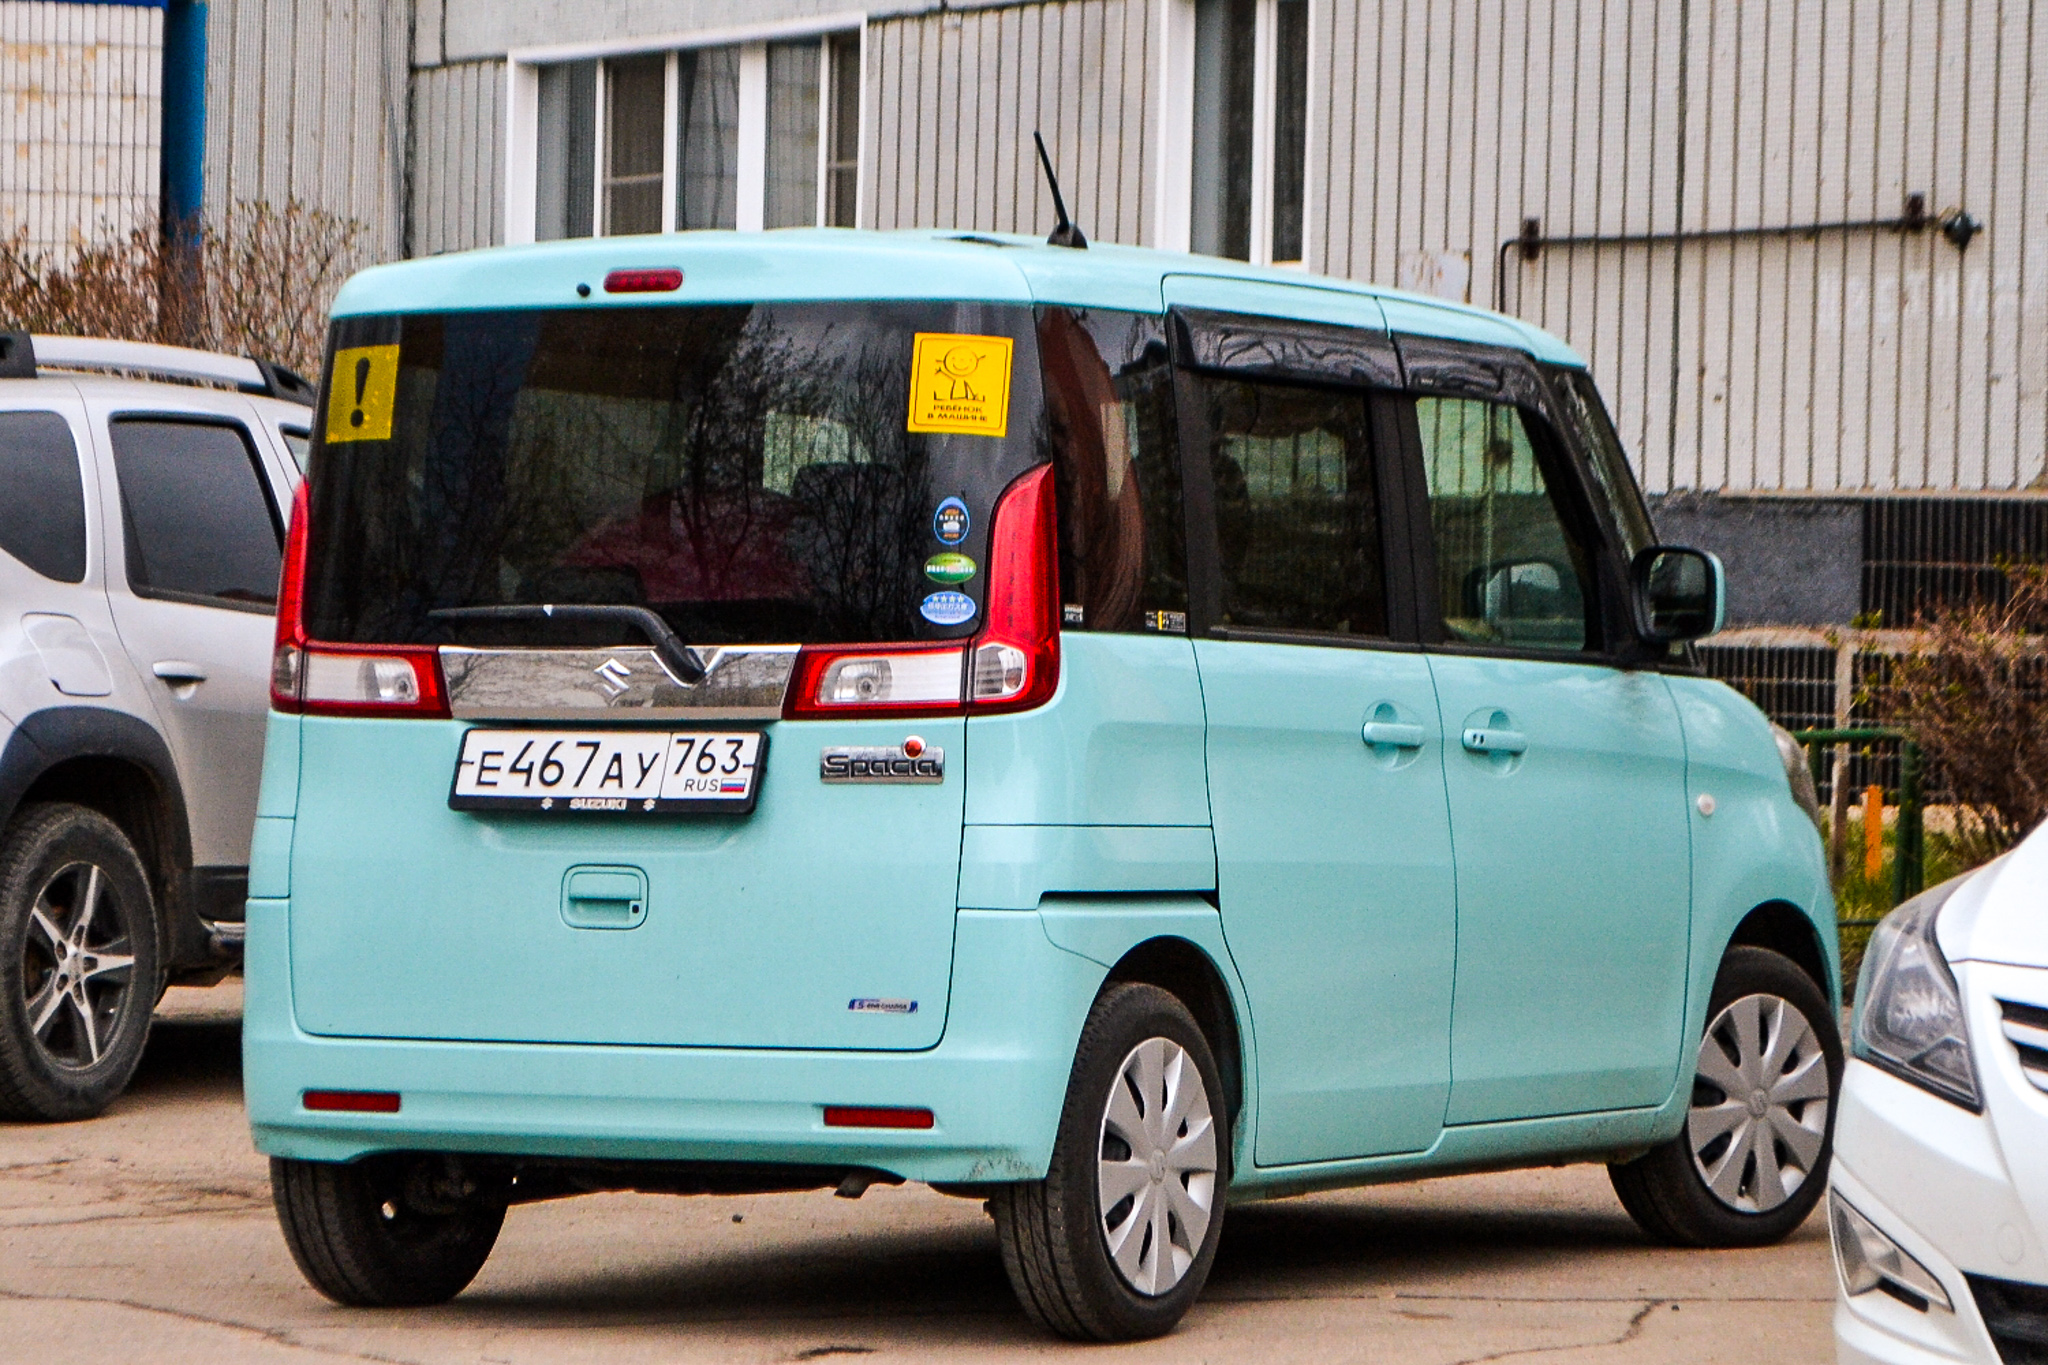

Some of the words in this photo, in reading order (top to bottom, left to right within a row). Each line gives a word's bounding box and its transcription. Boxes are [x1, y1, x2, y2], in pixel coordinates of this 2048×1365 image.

[674, 738, 744, 775] 763
[823, 746, 939, 778] Spacia
[683, 778, 719, 792] RUS
[569, 798, 628, 809] SUZUKI
